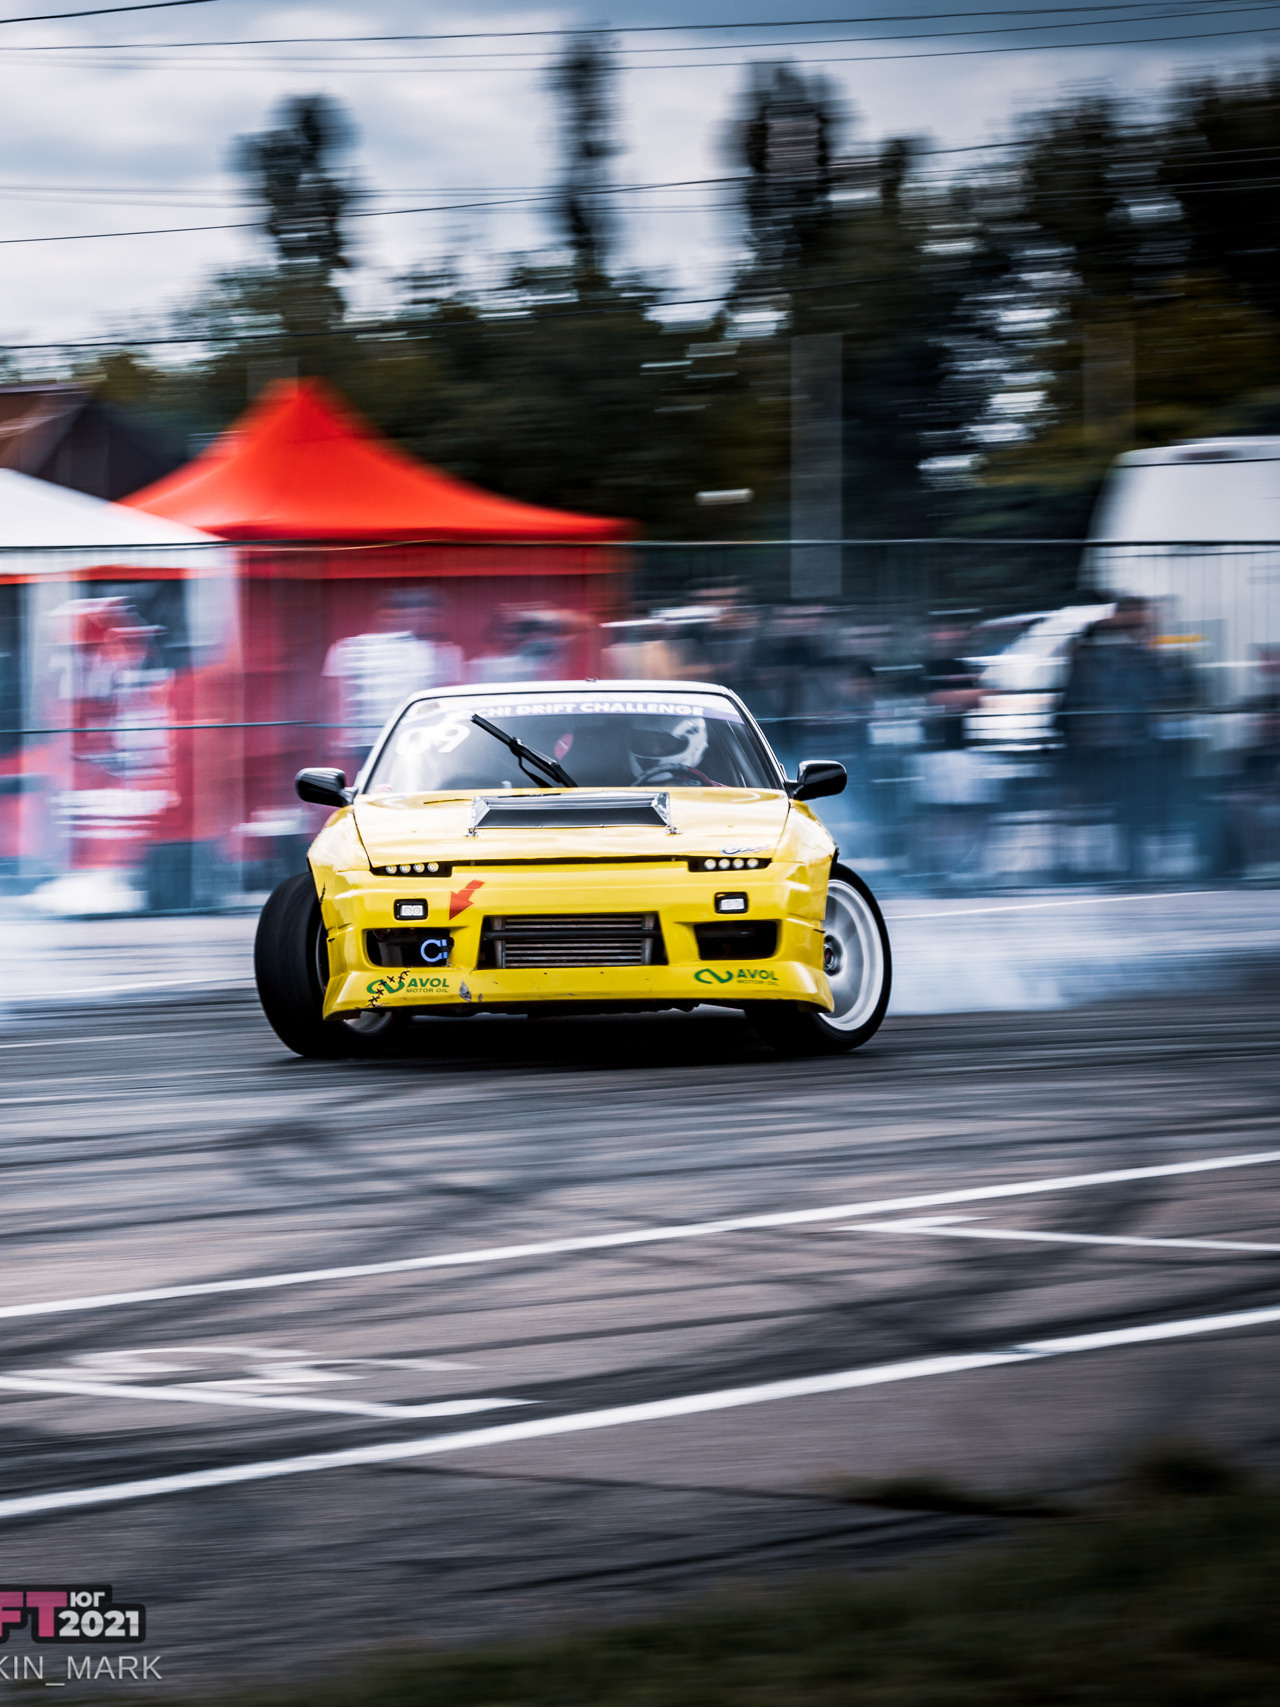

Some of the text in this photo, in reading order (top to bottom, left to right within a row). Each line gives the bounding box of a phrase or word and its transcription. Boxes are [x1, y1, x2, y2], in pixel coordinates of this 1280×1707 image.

[445, 702, 705, 722] OCHI DRIFT CHALLENGE
[395, 722, 471, 756] 09
[737, 969, 779, 980] AVOL
[407, 978, 450, 988] AVOL
